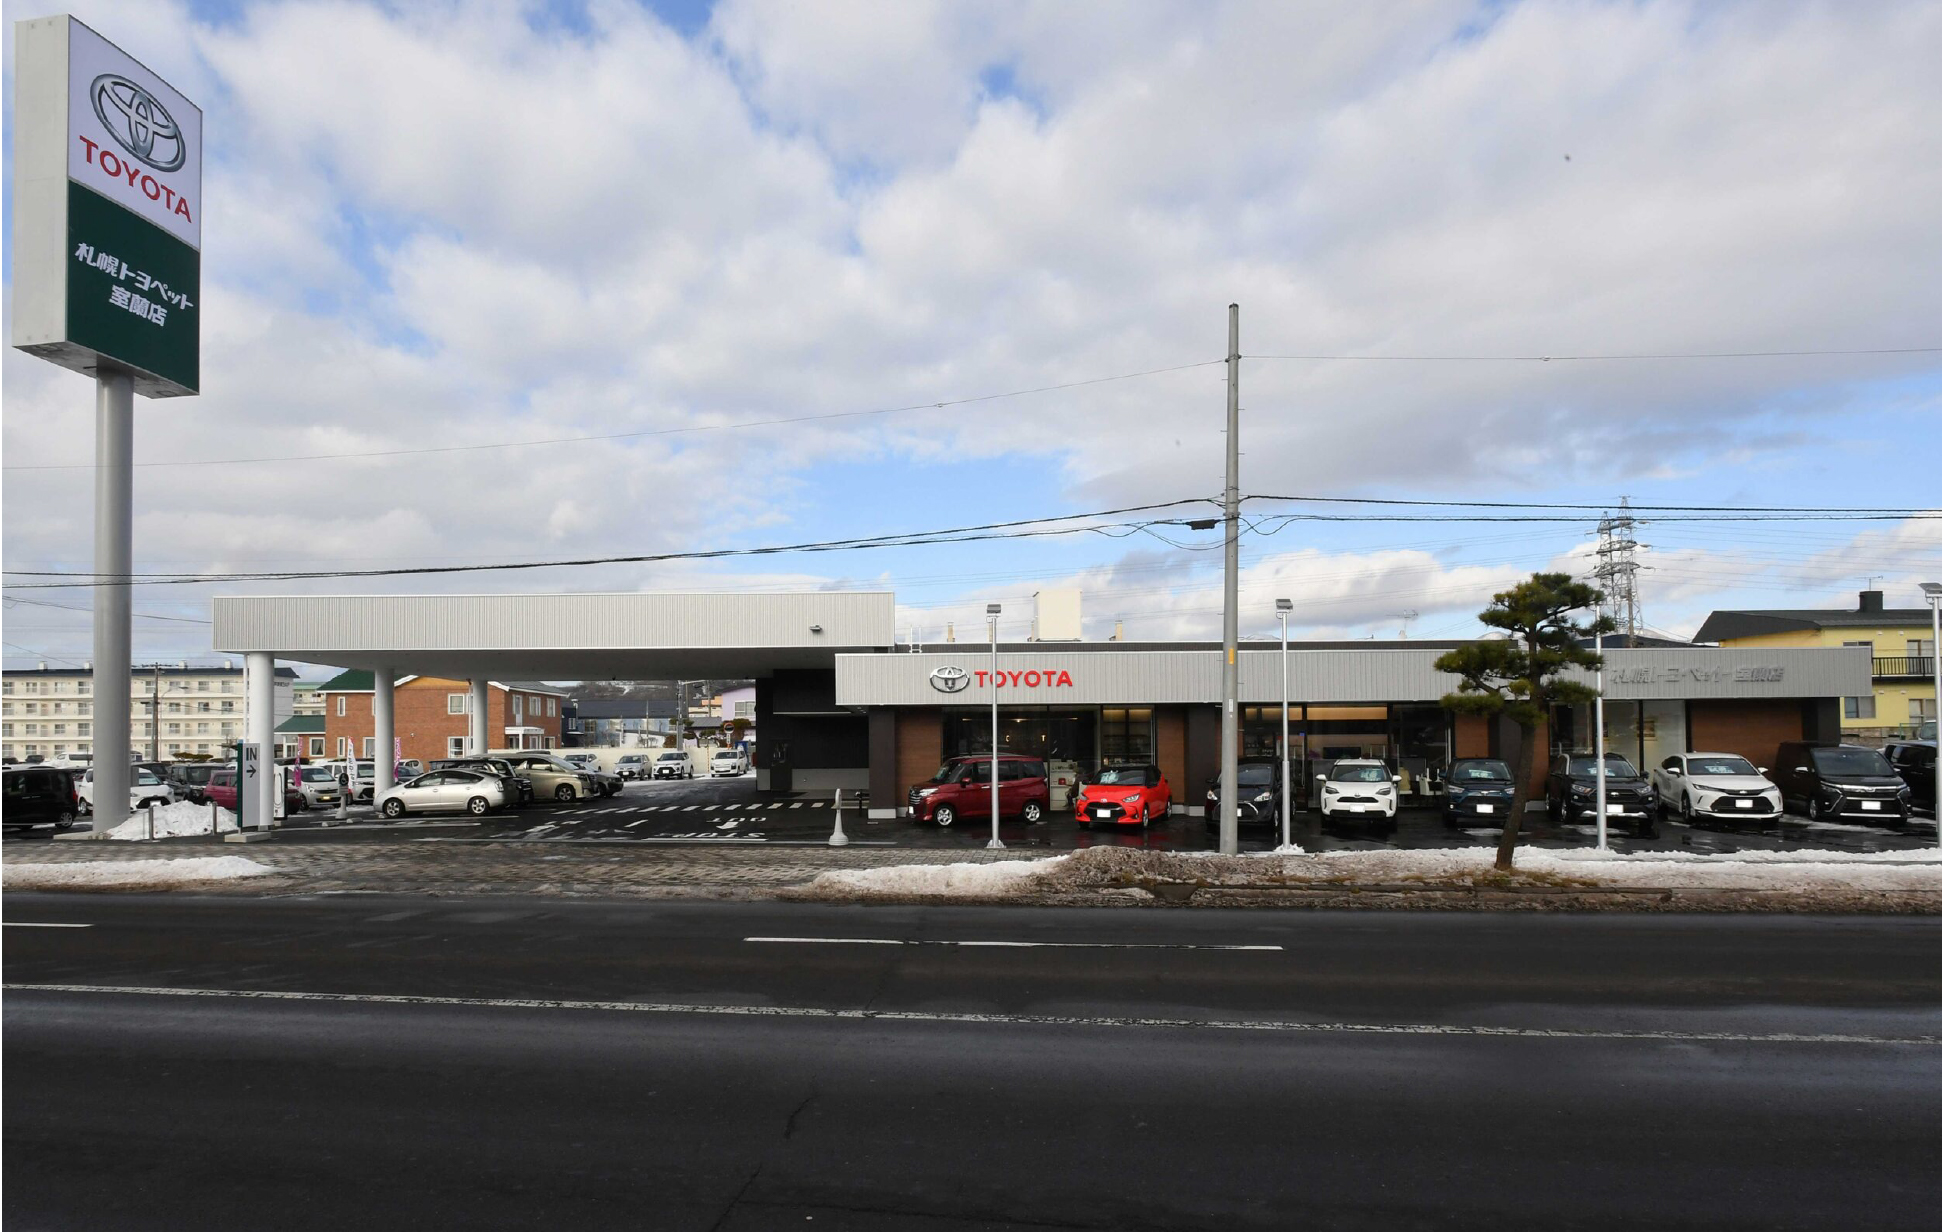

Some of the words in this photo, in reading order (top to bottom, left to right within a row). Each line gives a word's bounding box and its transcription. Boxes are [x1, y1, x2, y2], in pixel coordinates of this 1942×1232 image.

[79, 135, 192, 223] TOYOTA
[75, 243, 194, 310] 札幌トヨペット
[108, 284, 168, 327] 室蘭店
[974, 670, 1073, 688] TOYOTA
[246, 747, 258, 761] IN
